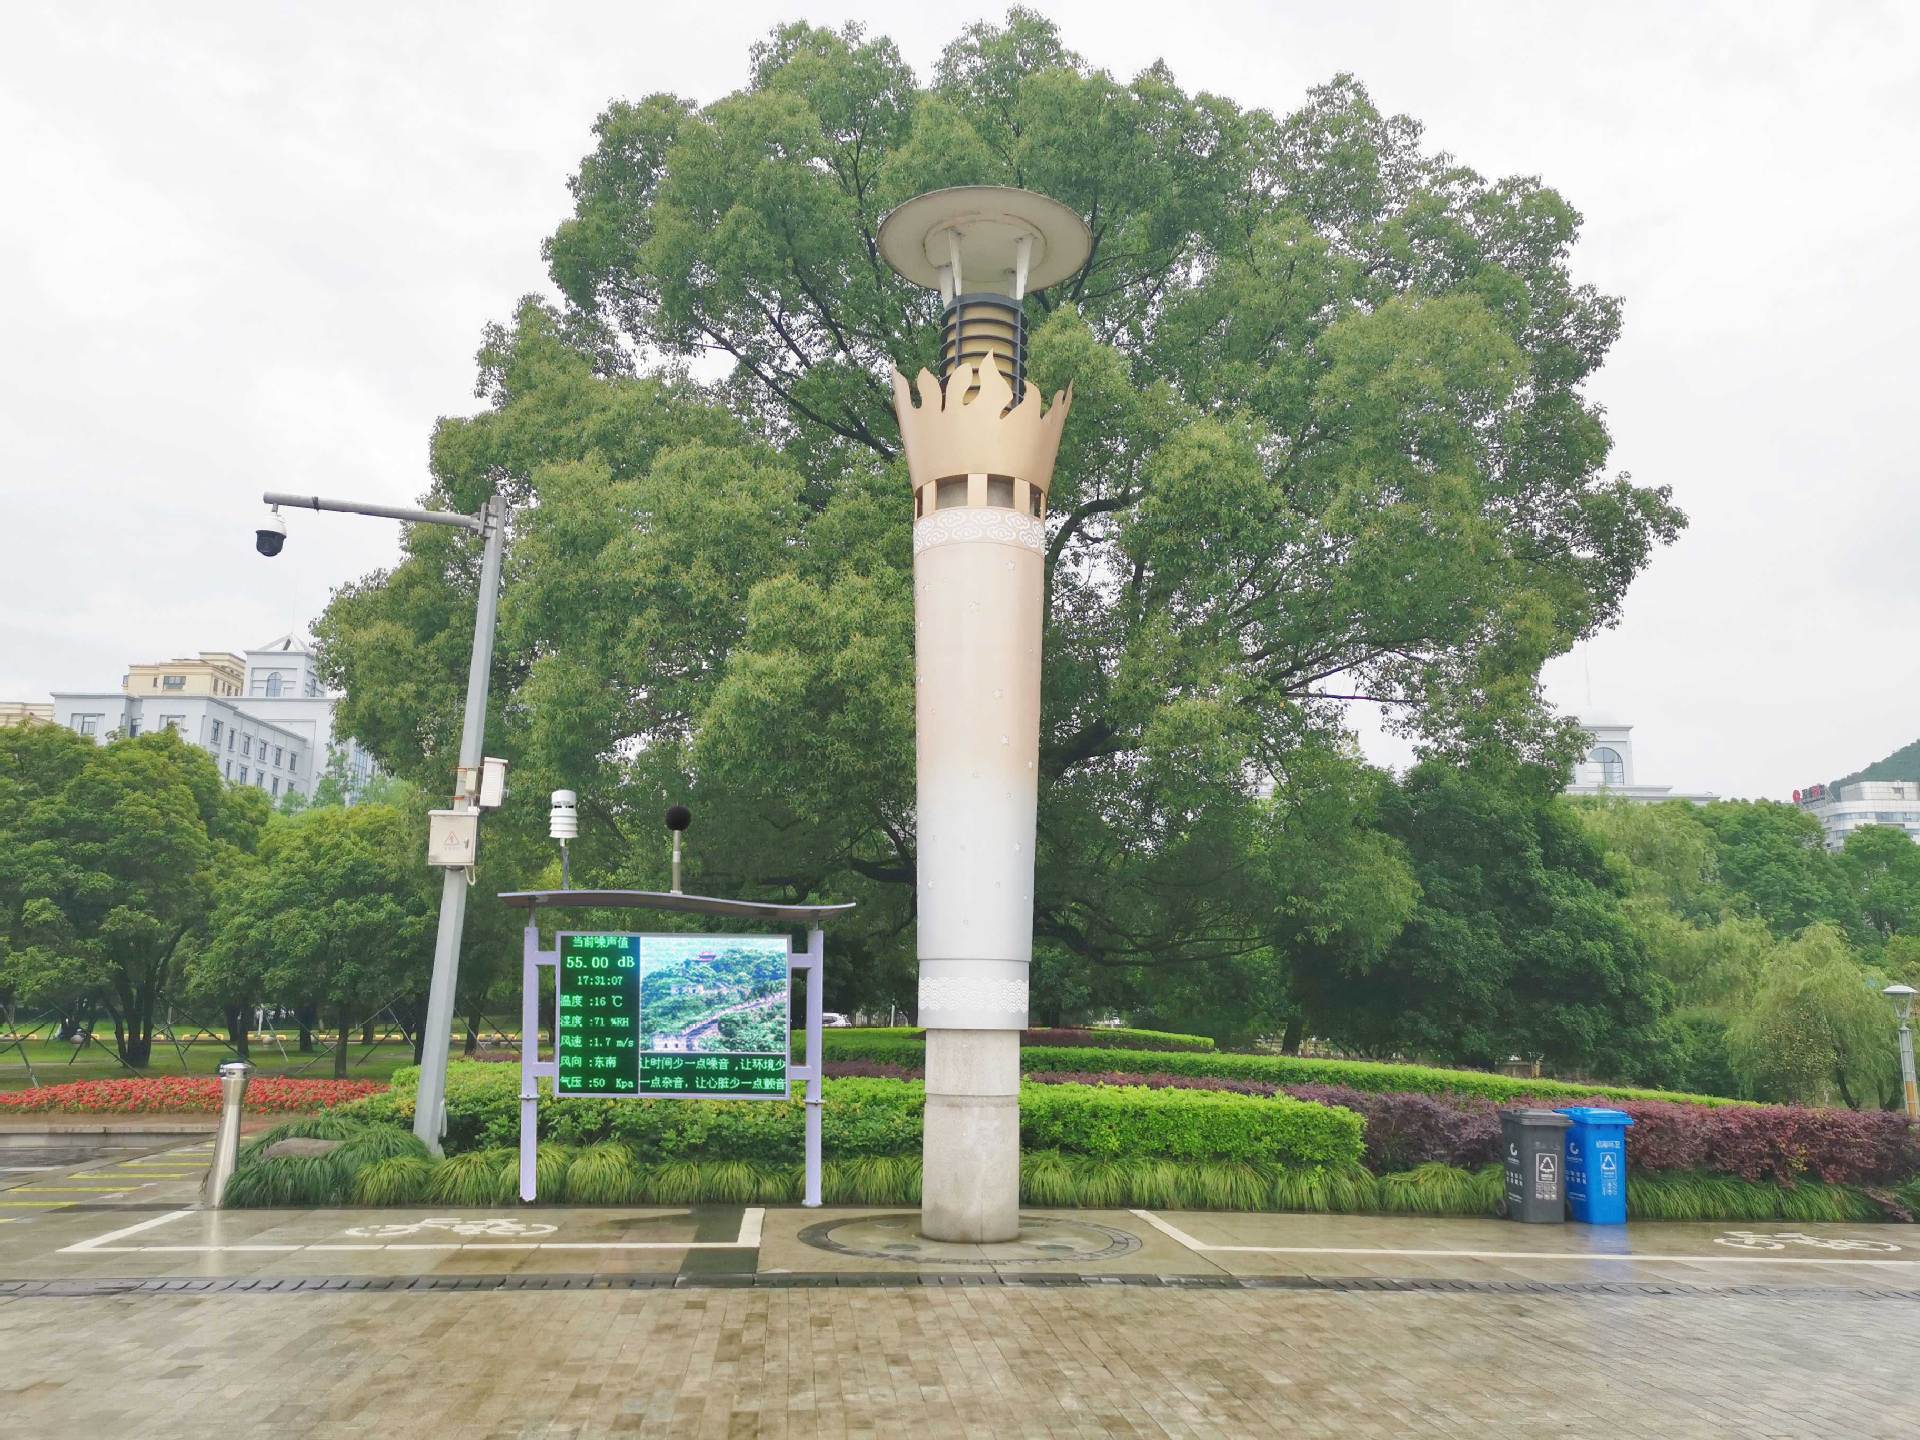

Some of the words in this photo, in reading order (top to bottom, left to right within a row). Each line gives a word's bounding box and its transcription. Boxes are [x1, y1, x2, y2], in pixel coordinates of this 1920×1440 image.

[572, 936, 629, 949] 当前噪声值
[566, 956, 609, 969] 55.00
[617, 956, 636, 968] dB
[577, 975, 623, 986] 17:31:07
[560, 995, 583, 1008] 温度
[589, 996, 606, 1007] :16
[560, 1015, 583, 1028] 湿度
[589, 1016, 604, 1027] :71
[610, 1017, 629, 1027] %RH
[560, 1035, 582, 1048] 风速
[615, 1037, 634, 1048] m/s
[560, 1056, 582, 1068] 风向
[560, 1076, 582, 1089] 气压
[588, 1078, 606, 1088] :50
[615, 1078, 634, 1089] Kpa
